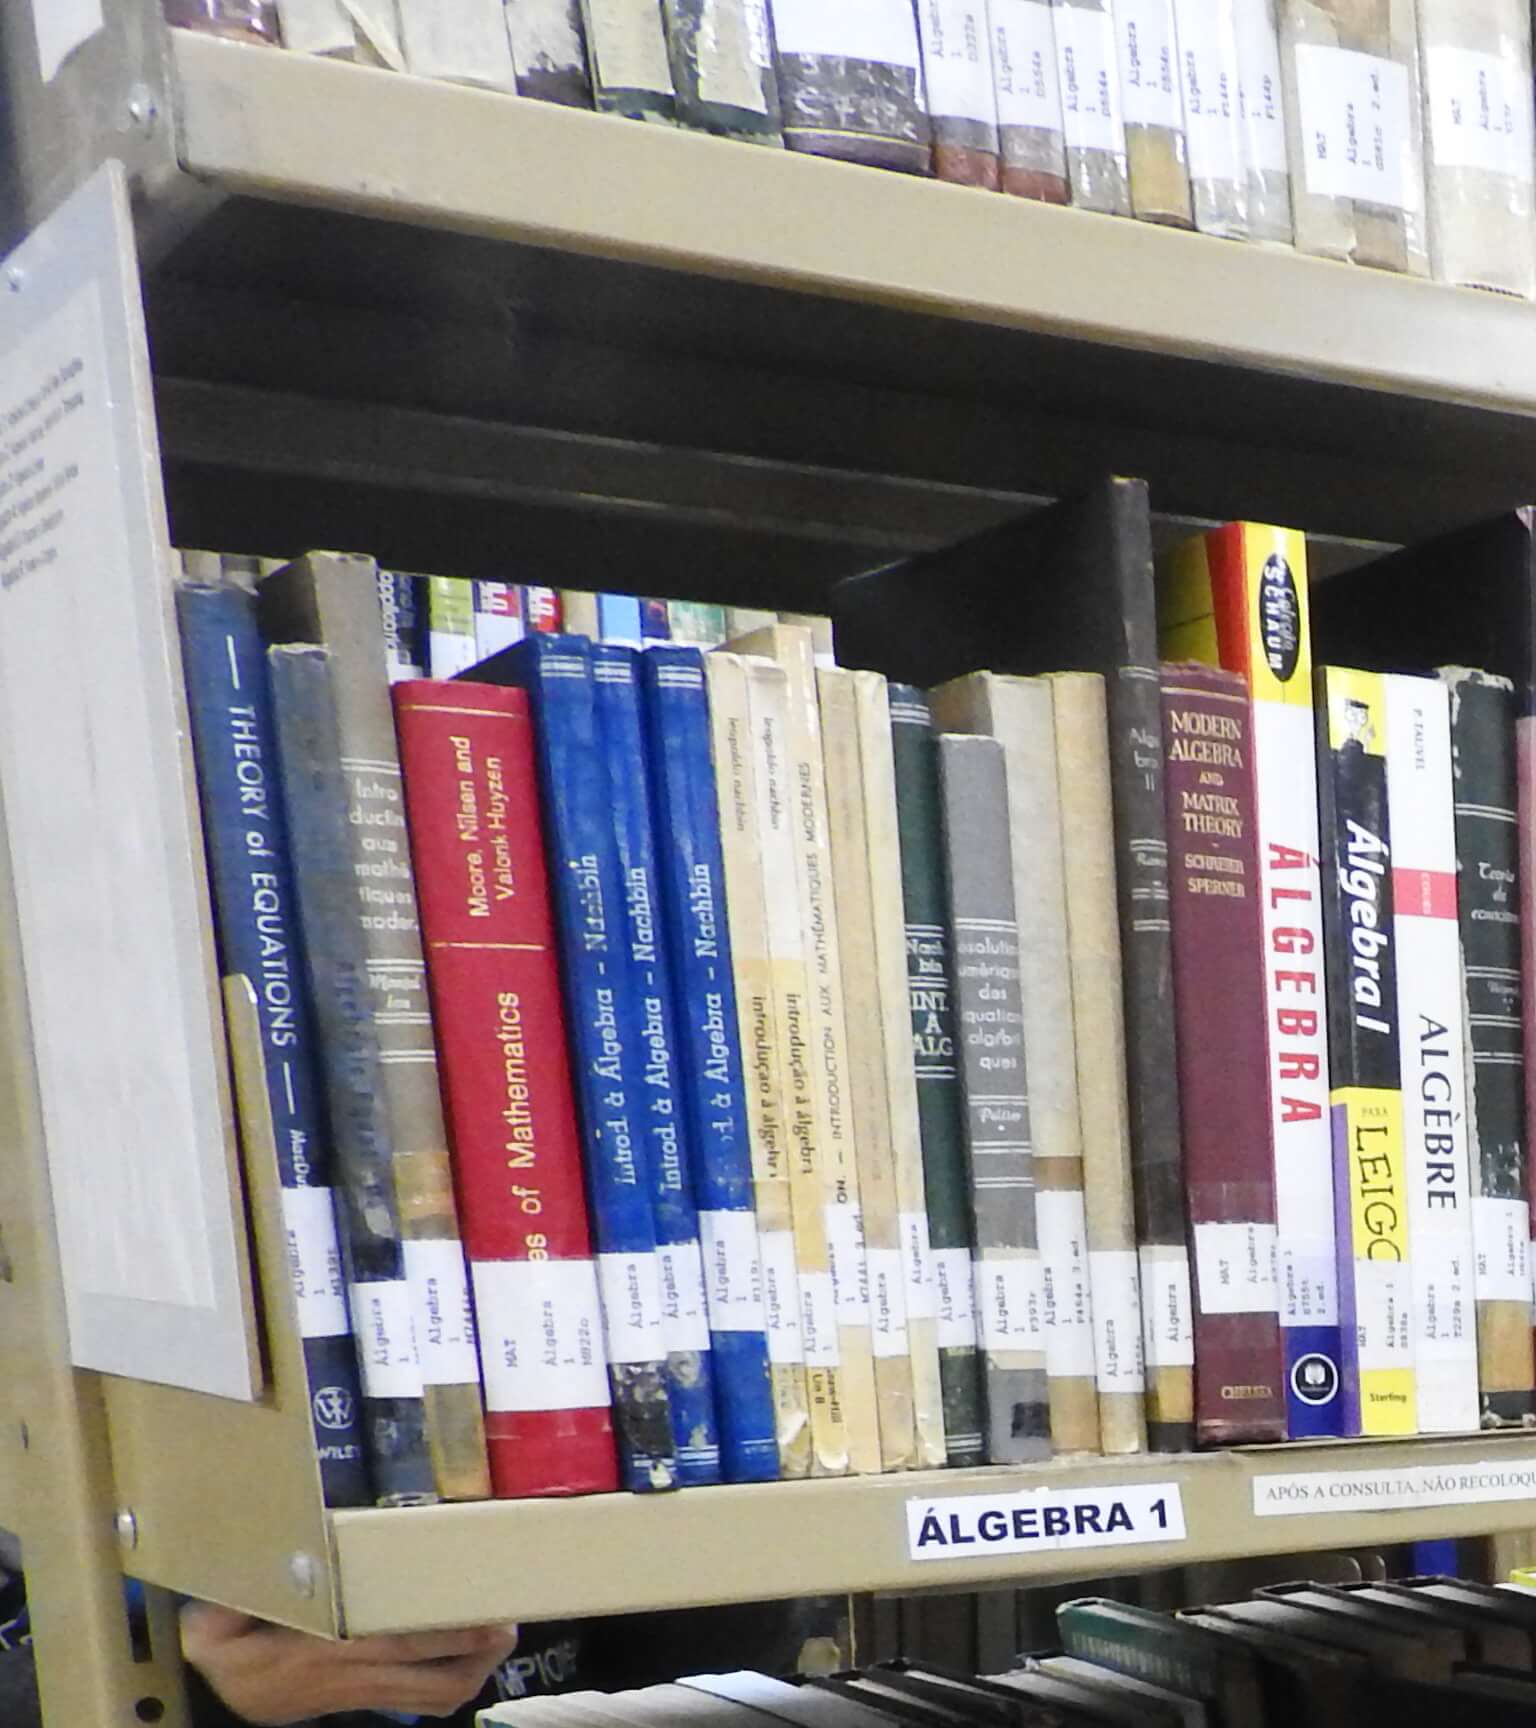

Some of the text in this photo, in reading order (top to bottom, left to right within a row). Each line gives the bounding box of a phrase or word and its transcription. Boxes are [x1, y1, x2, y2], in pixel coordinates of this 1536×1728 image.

[1170, 709, 1242, 740] MODERN
[450, 736, 474, 774] and
[1168, 740, 1243, 769] ALGEBRA
[1199, 772, 1224, 787] AND
[1183, 791, 1239, 818] MATRIX
[1183, 812, 1242, 839] THEORY
[228, 706, 298, 1050] THEORY of EQUATIONS
[626, 867, 655, 963] Nachbin
[688, 863, 717, 959] Nachbin
[1337, 819, 1390, 1008] Álgebra
[1268, 842, 1322, 1122] ÁLGEBRA
[507, 990, 543, 1216] of Mathematics
[1418, 1014, 1461, 1209] ALGÈBRE
[1266, 1482, 1309, 1501] APÓS
[1314, 1484, 1326, 1498] A
[1422, 1473, 1457, 1493] NÃO
[917, 1498, 1169, 1547] ÁLGEBRA 1
